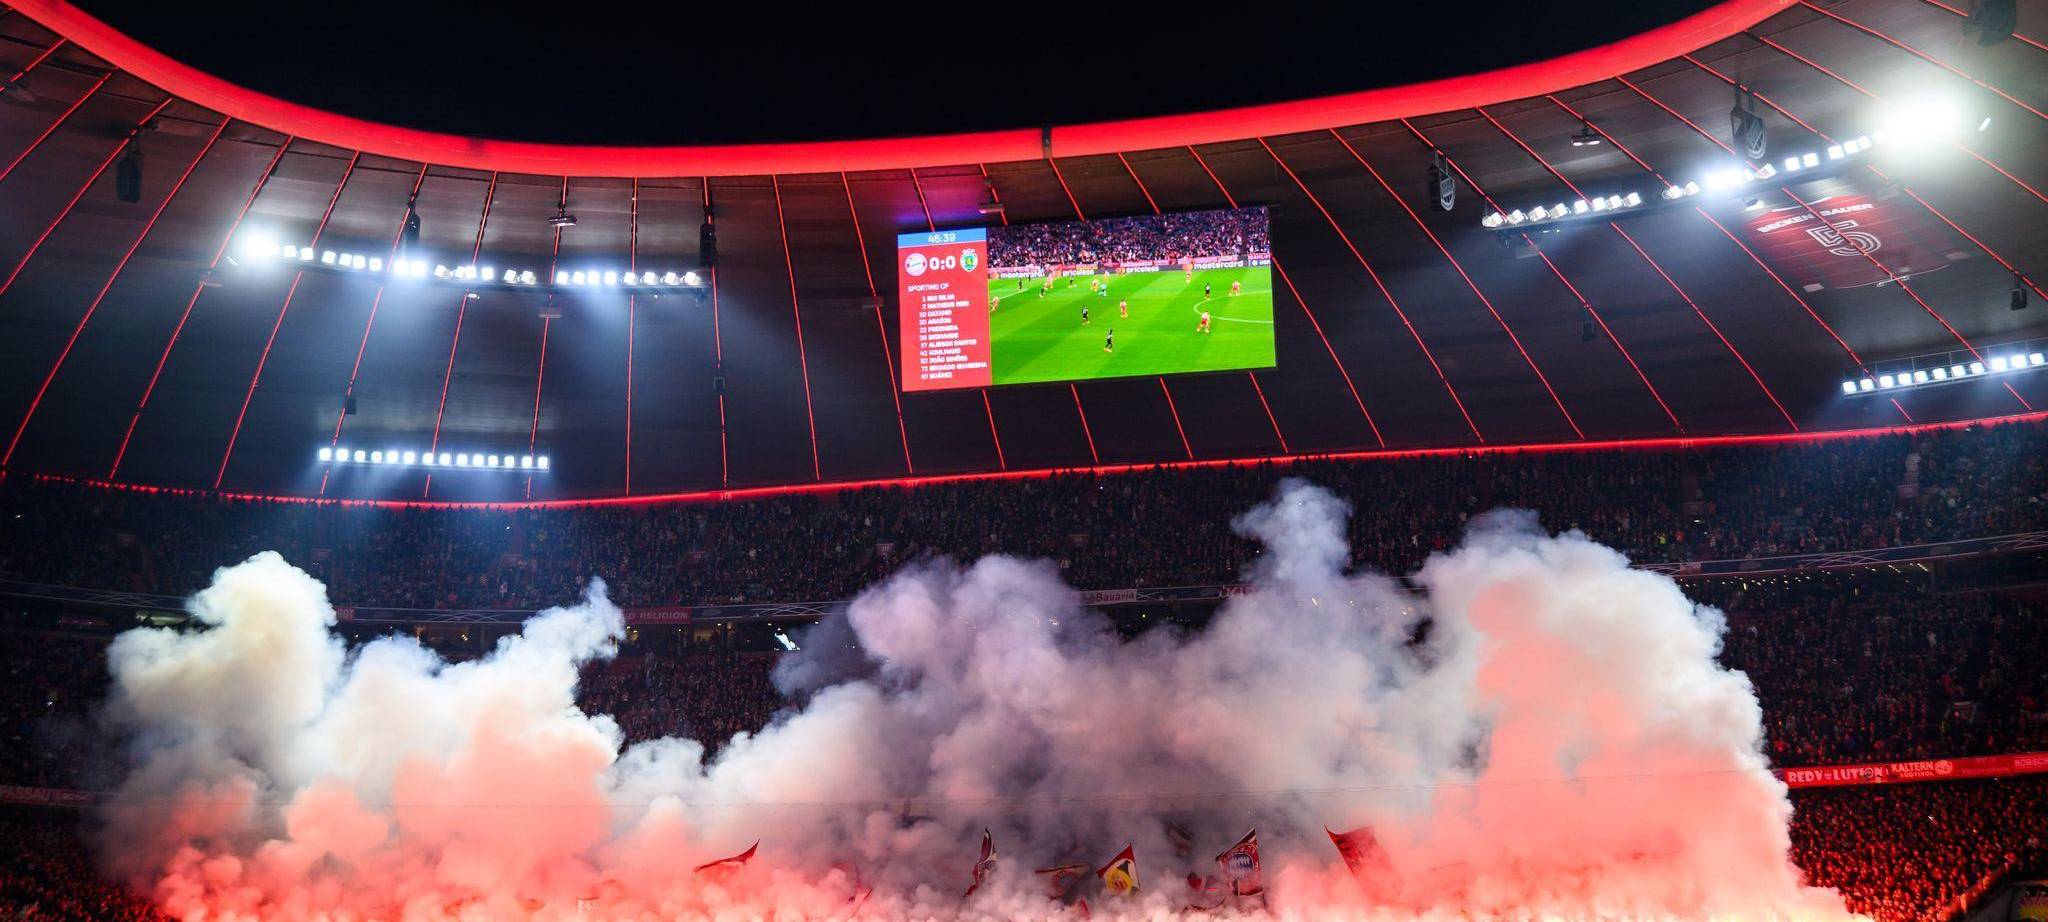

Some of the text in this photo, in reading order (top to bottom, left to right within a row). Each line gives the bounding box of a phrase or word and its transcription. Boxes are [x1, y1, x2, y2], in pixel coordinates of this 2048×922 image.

[1806, 220, 1881, 256] 5
[1194, 260, 1243, 269] mastercard
[908, 284, 939, 292] SPORTING
[1891, 761, 1934, 772] KALTERN
